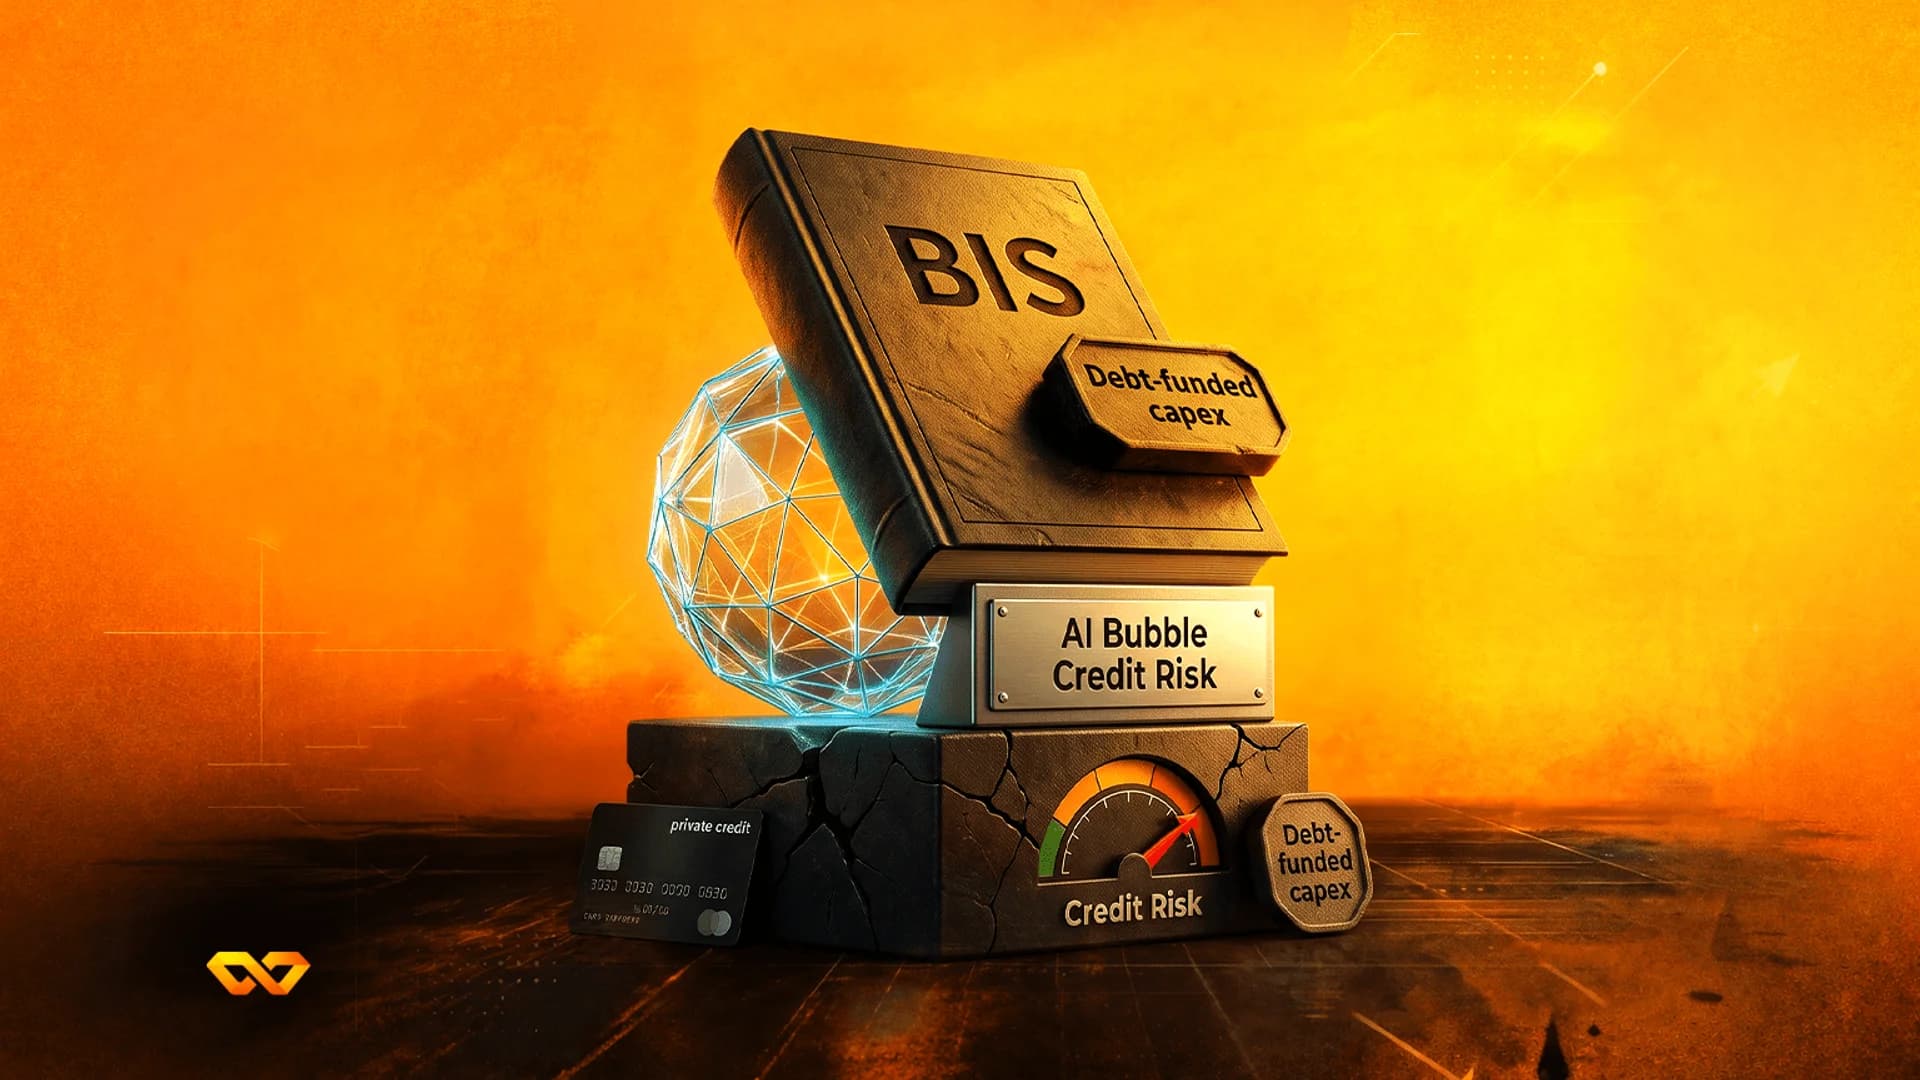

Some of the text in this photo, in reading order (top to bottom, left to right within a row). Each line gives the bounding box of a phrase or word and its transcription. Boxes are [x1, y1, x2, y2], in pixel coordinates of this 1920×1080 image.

[884, 225, 1085, 317] BIS
[1083, 364, 1258, 398] Debt-funded
[1149, 403, 1231, 430] capex
[1061, 616, 1208, 648] AI Bubble
[1053, 657, 1217, 691] Credit Risk
[670, 818, 751, 834] private credit
[1283, 822, 1341, 846] Debt-
[1278, 848, 1353, 875] funded
[1064, 889, 1203, 927] Credit Risk
[1290, 880, 1352, 907] capex
